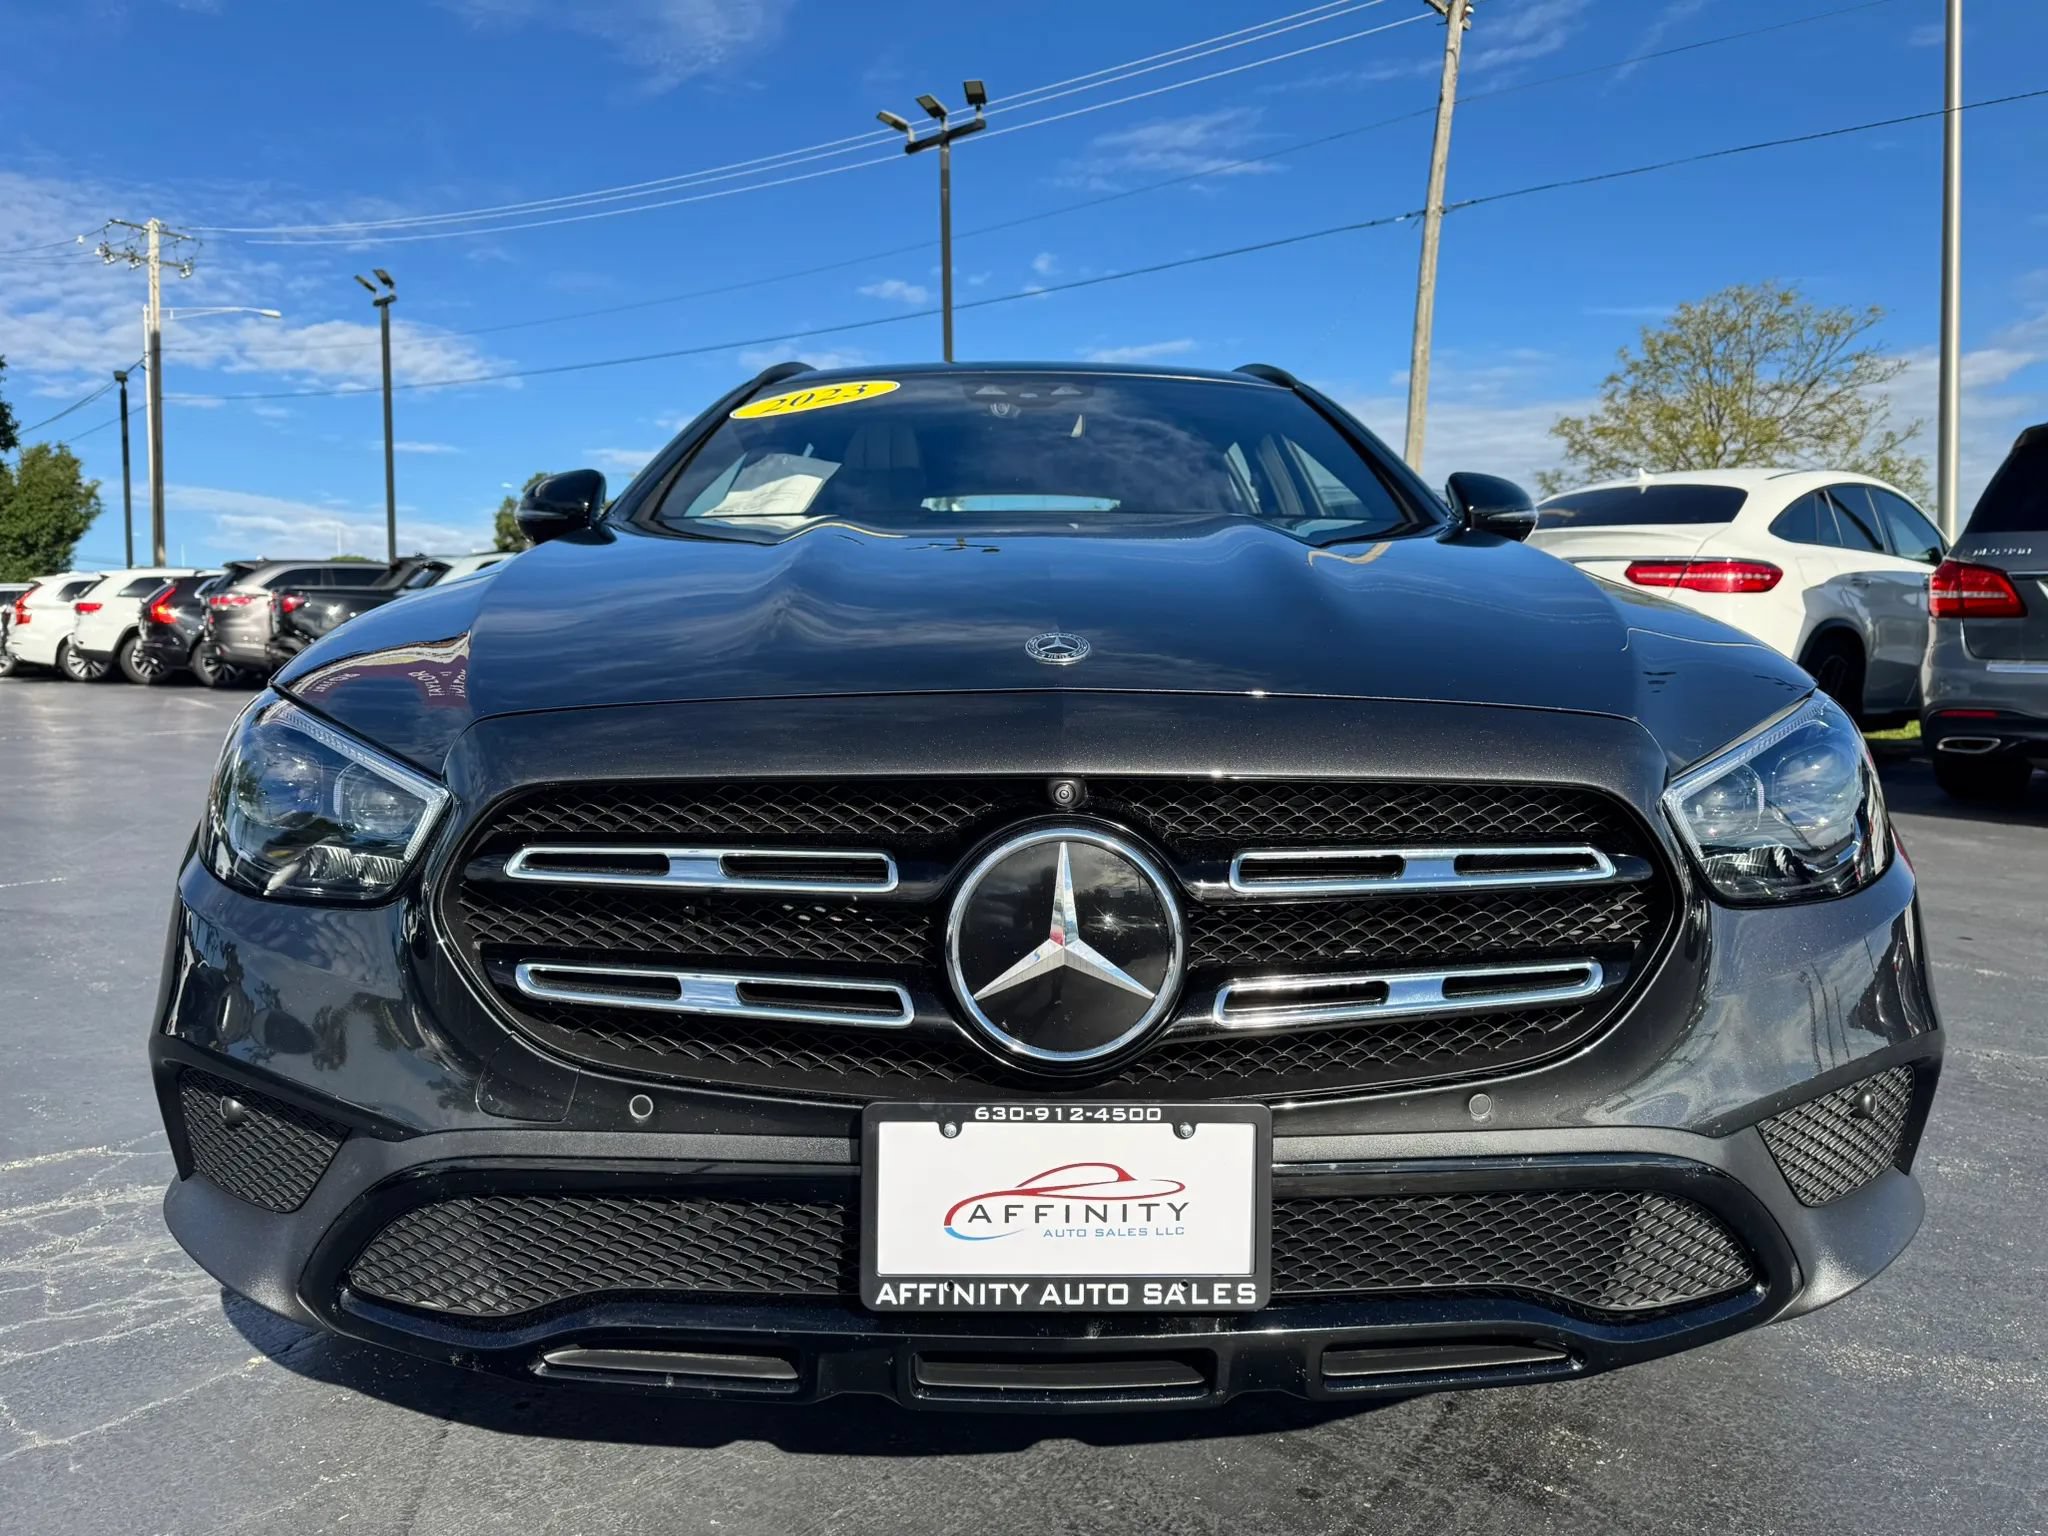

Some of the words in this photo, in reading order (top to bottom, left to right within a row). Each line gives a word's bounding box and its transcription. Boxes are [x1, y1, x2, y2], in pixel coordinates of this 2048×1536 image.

[974, 1106, 1162, 1122] 630-912-4500
[967, 1201, 1190, 1224] AFFINITY
[1042, 1228, 1088, 1238] AUTO
[1095, 1227, 1148, 1237] SALES
[1155, 1226, 1186, 1236] LLC
[874, 1282, 1030, 1306] AFFINITY
[1039, 1282, 1129, 1306] AUTO
[1142, 1282, 1257, 1306] SALES
